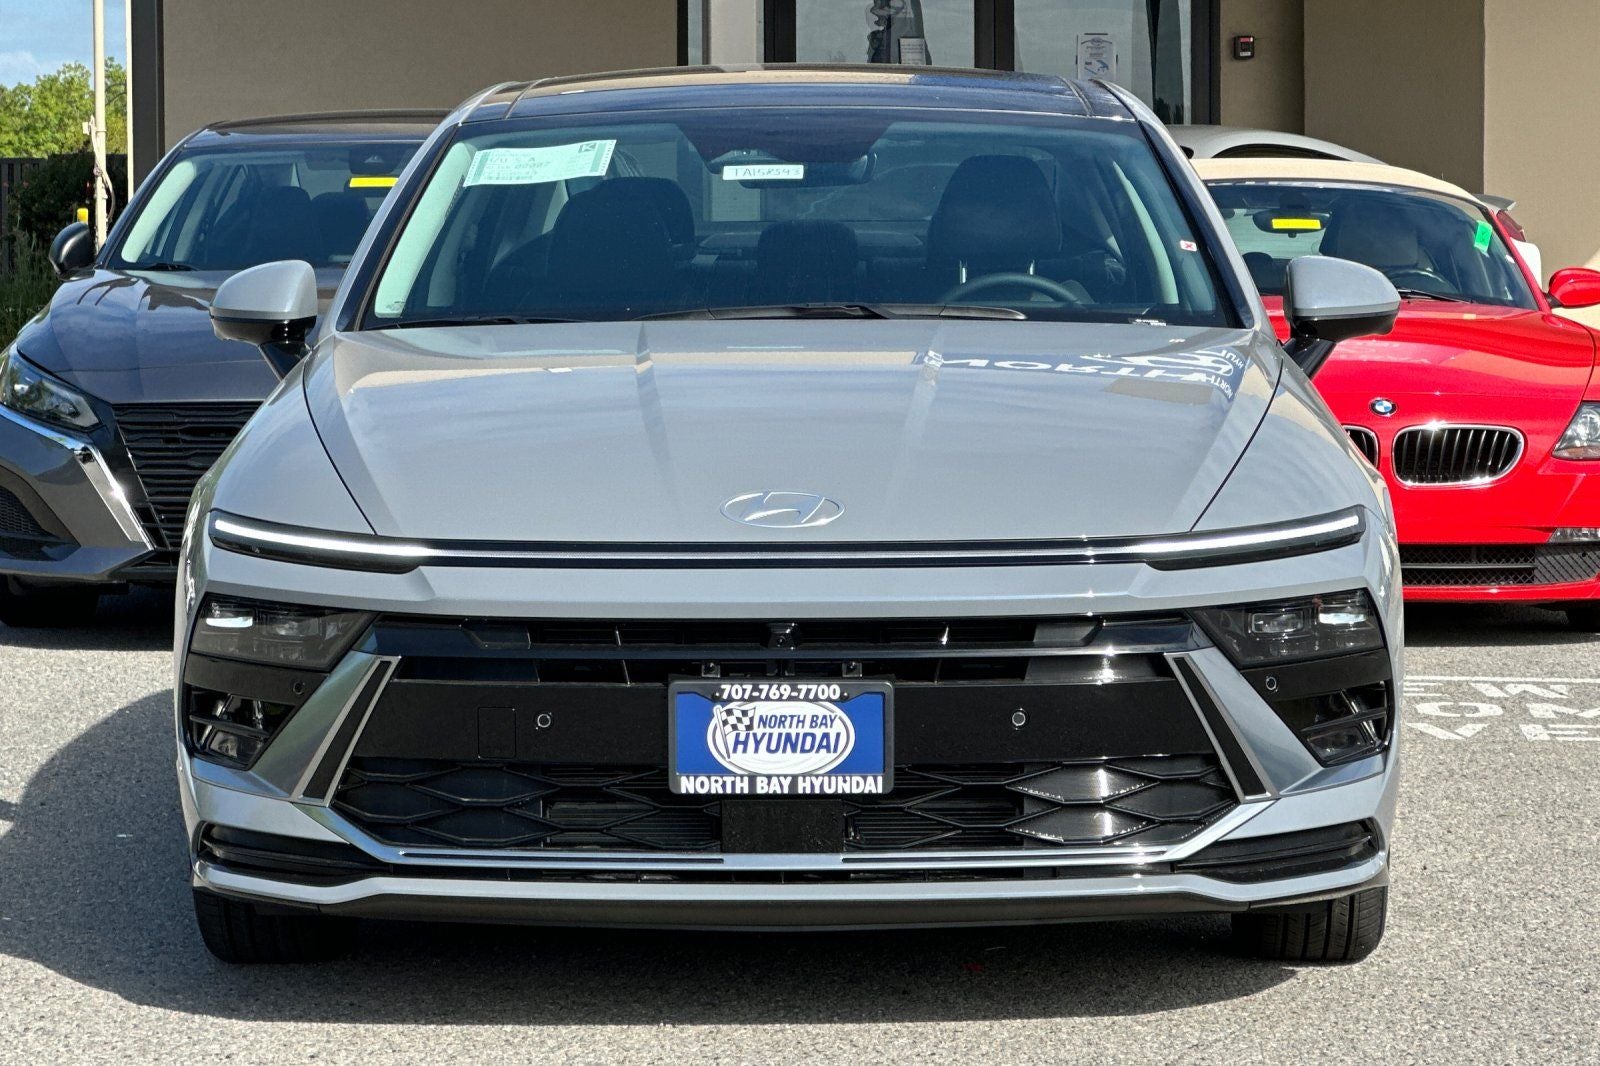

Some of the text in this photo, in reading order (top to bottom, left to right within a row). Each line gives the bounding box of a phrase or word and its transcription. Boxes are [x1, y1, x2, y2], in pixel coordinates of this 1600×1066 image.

[720, 684, 841, 700] 707-769-7700
[757, 714, 838, 729] NORTH BAY
[732, 732, 842, 754] HYUNDAI
[680, 776, 883, 794] NORTH BAY HYUNDAI
